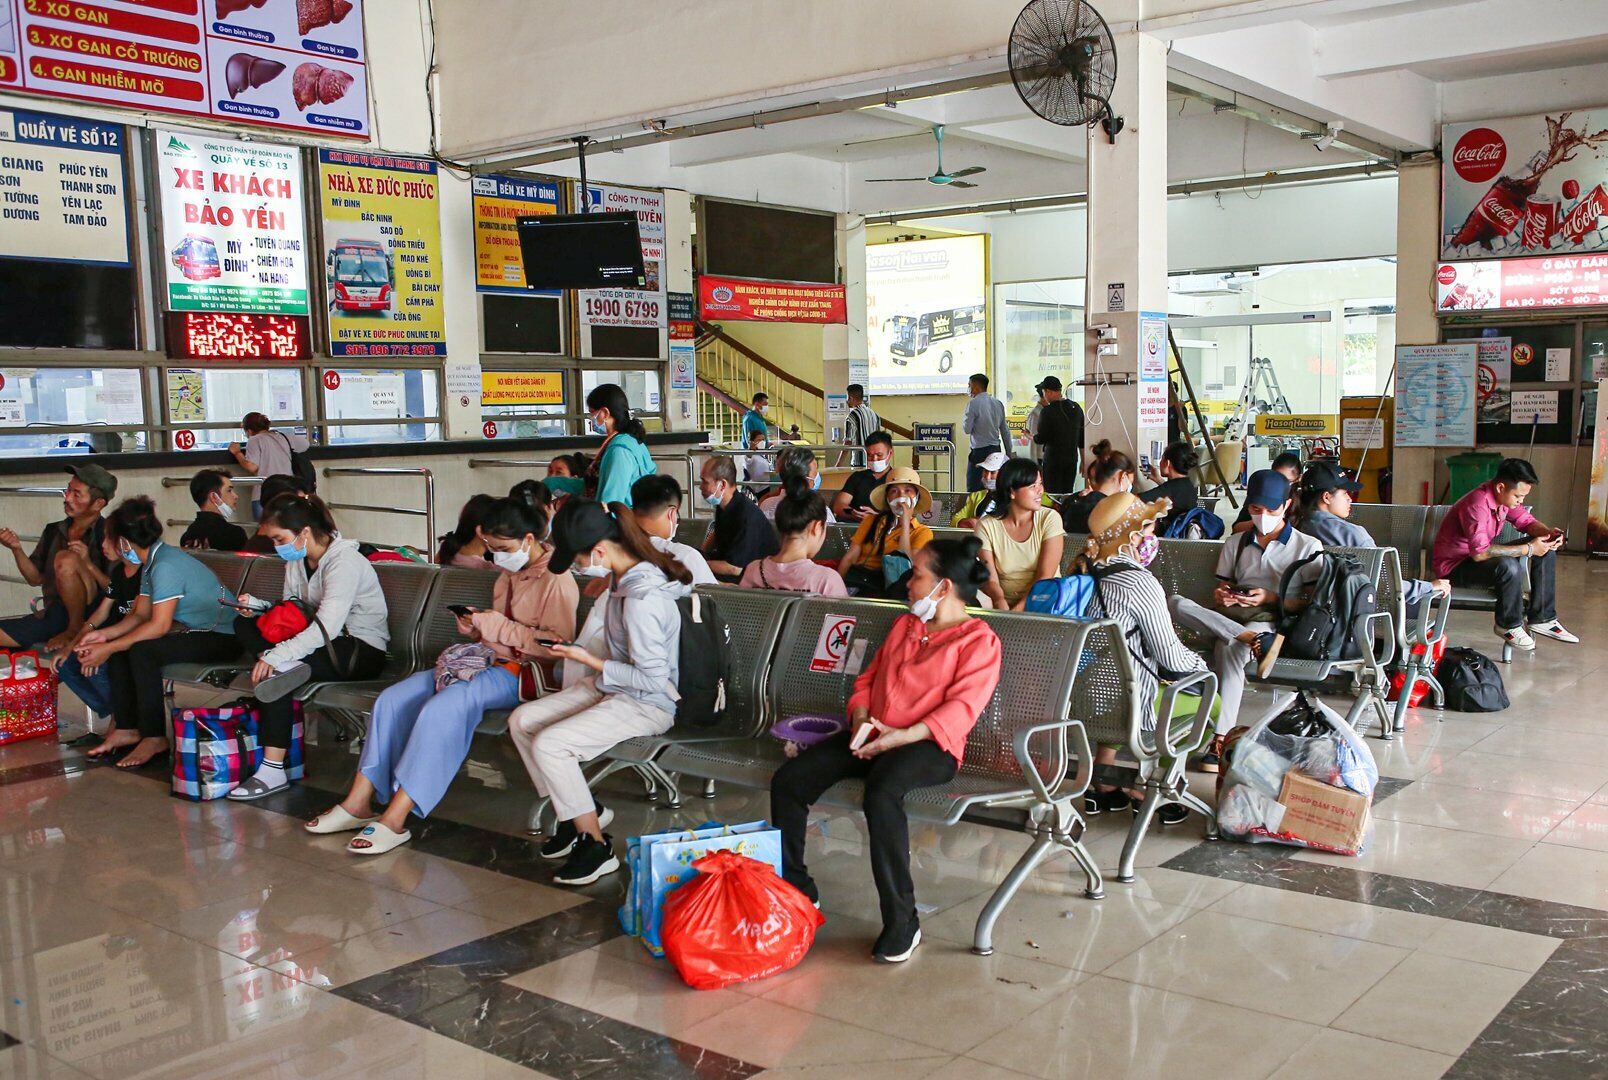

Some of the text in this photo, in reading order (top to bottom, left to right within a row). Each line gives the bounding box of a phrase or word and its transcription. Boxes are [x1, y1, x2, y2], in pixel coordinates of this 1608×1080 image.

[46, 2, 71, 17] XƠ
[75, 7, 109, 24] GAN
[30, 31, 199, 70] 3. XƠ GAN CỔ TRƯỚNG
[33, 64, 165, 94] 4. GAN NHIỄM MỠ
[18, 120, 118, 146] QUẦY VÉ SỐ 12
[204, 143, 219, 151] CÔNG
[2, 156, 44, 172] GIANG
[59, 163, 108, 178] PHÚC YÊN
[243, 157, 257, 167] VÉ
[276, 162, 288, 170] 13
[60, 180, 117, 195] THANH SƠN
[174, 167, 292, 199] XE KHÁCH
[328, 171, 434, 199] NHÀ XE ĐỨC PHÚC
[499, 181, 556, 200] BẾN XE MỸ ĐÌNH
[4, 191, 39, 205] TƯỜNG
[62, 196, 103, 212] YÊN LẠC
[344, 197, 361, 208] ĐÌNH
[608, 193, 659, 206] CÔNG TY TNHH
[3, 208, 40, 221] DƯƠNG
[63, 212, 107, 227] TAM ĐẢO
[185, 198, 286, 230] BẢO YẾN
[376, 214, 393, 222] NINH
[637, 210, 662, 224] UYÊN
[380, 227, 392, 235] SAO
[224, 257, 249, 272] ĐÌNH
[1554, 258, 1578, 269] ĐÂY
[1582, 257, 1608, 268] BÁN
[259, 272, 269, 284] NA
[586, 298, 621, 317] 1900
[624, 300, 659, 318] 6799
[363, 330, 372, 338] XE
[406, 330, 429, 339] ONLINE
[369, 344, 389, 355] 096
[411, 344, 436, 356] 3979
[325, 374, 338, 386] 14
[484, 425, 496, 436] 15
[178, 432, 193, 446] 13
[1290, 793, 1311, 804] SHOP
